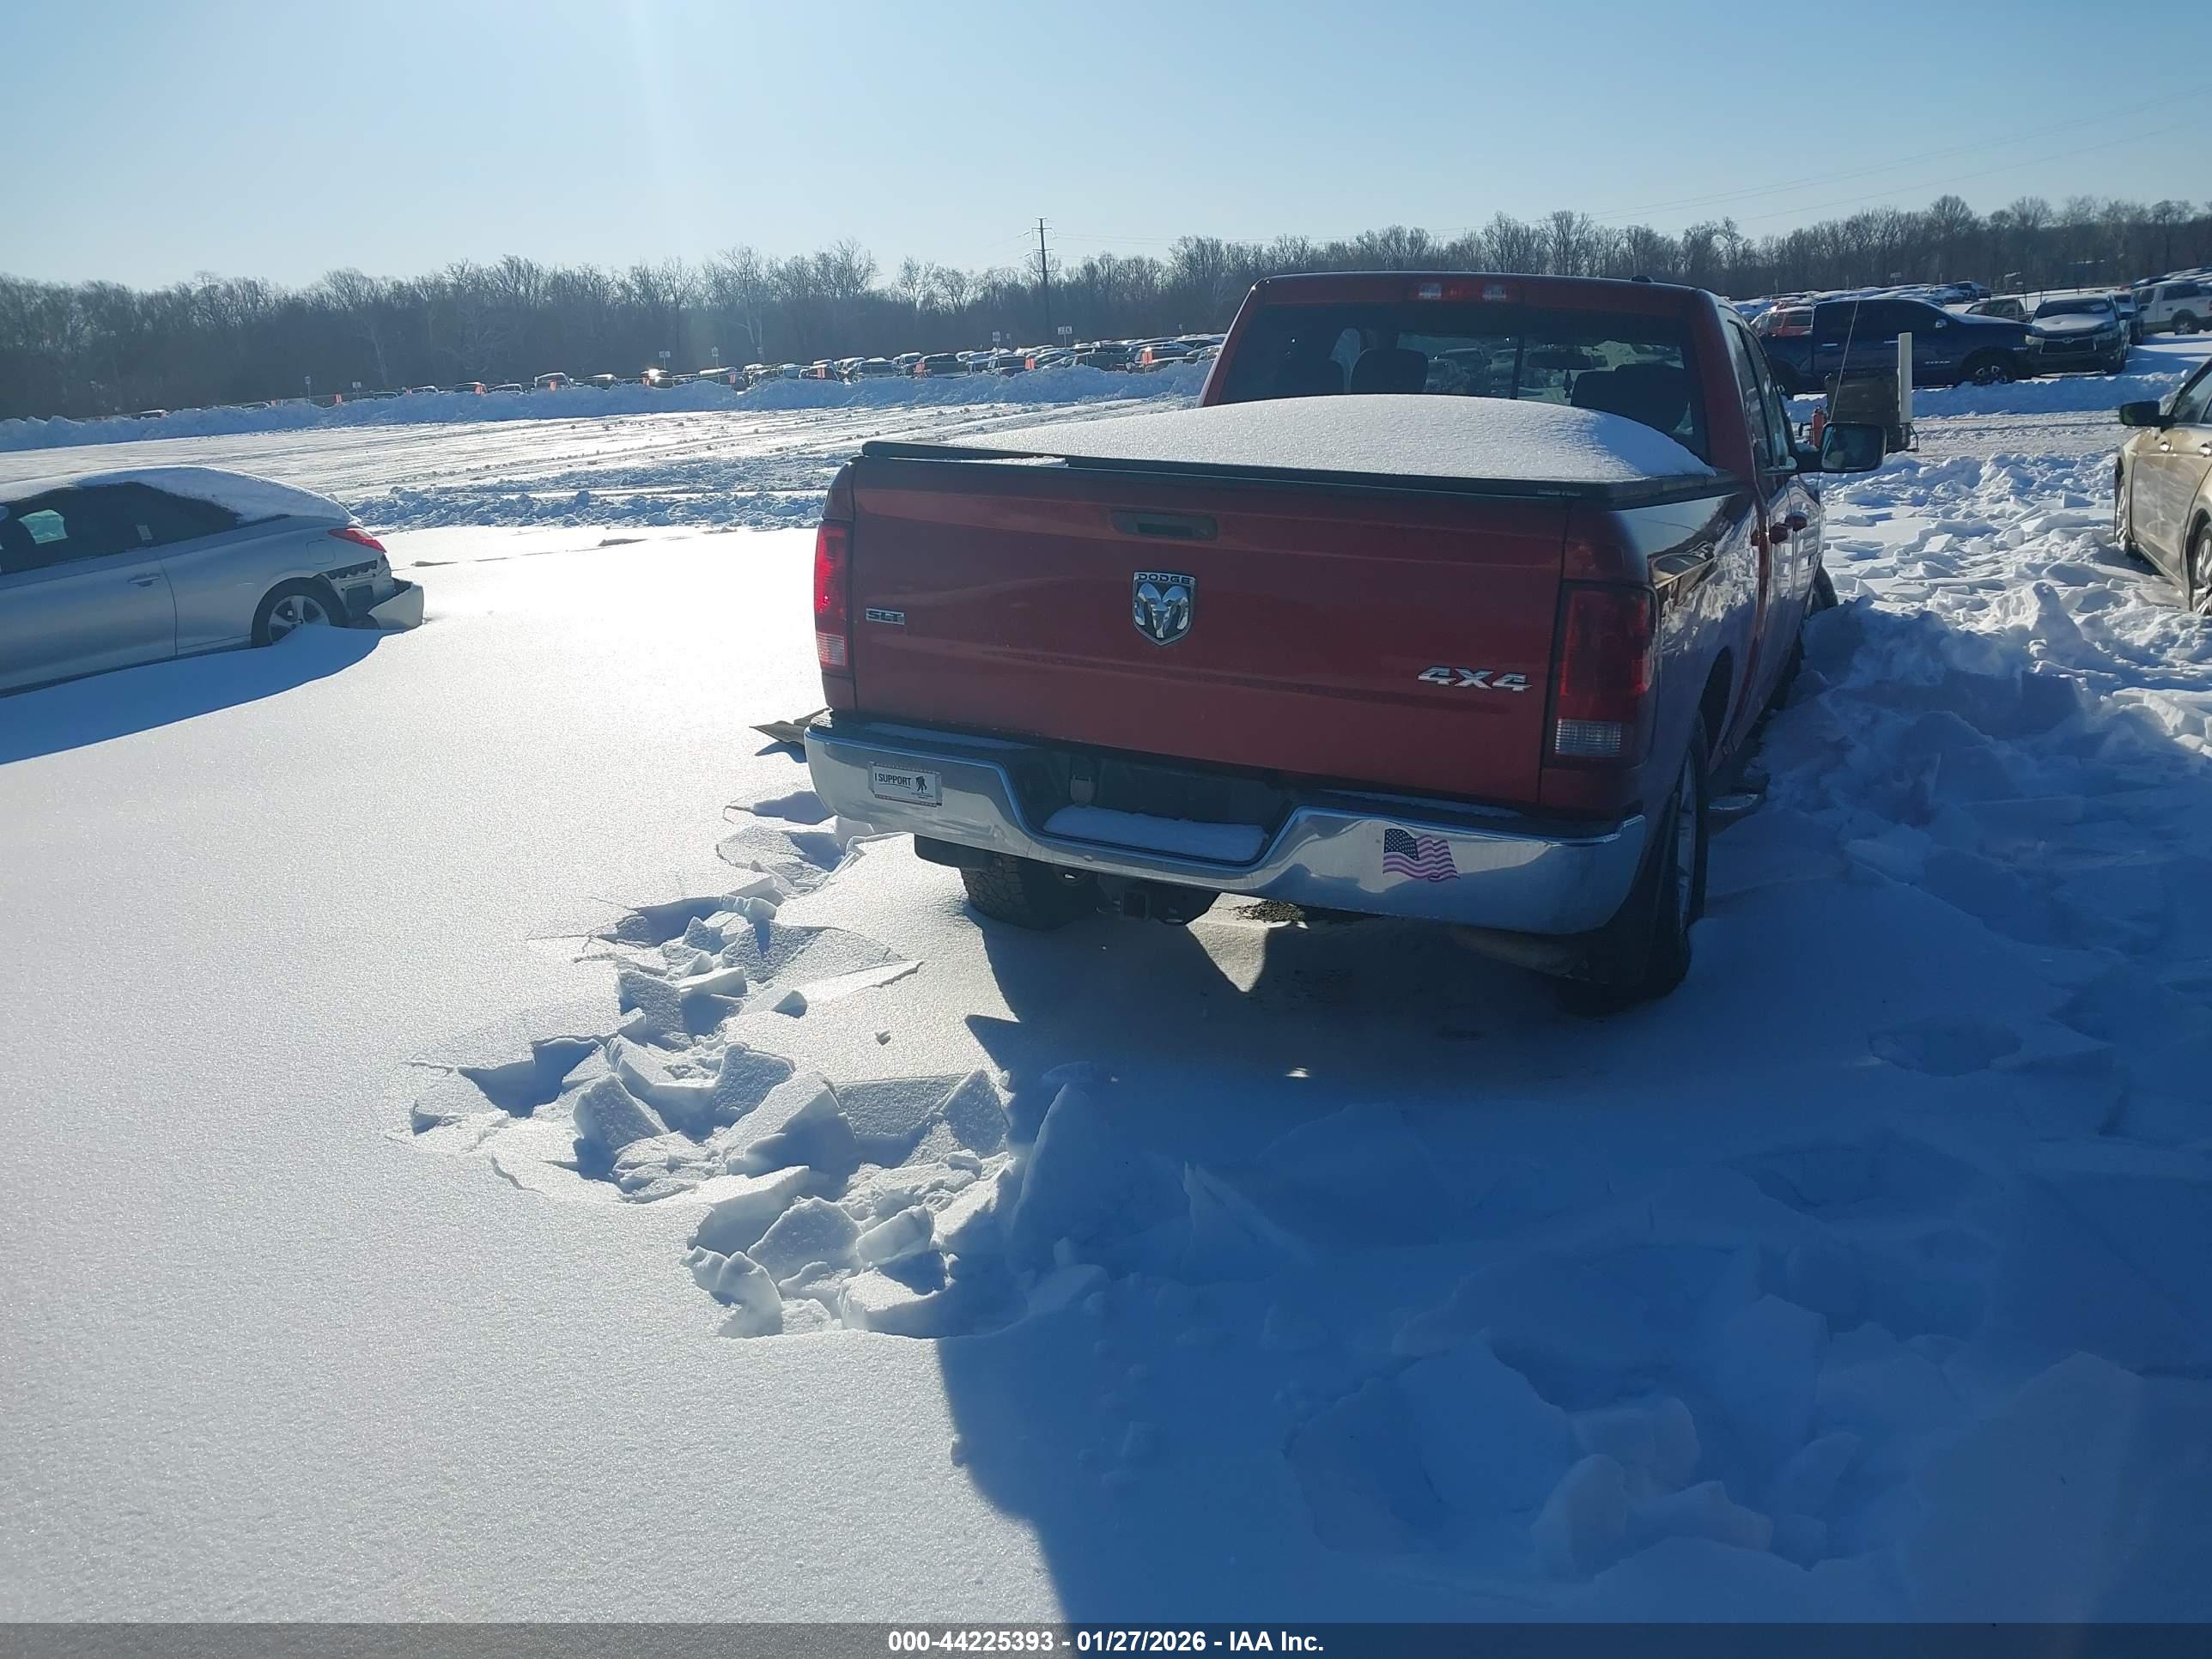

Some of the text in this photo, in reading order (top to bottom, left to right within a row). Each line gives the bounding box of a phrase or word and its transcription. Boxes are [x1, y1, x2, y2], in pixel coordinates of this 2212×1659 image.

[1138, 573, 1191, 585] DODGE
[866, 609, 903, 623] SLT
[1417, 666, 1533, 692] 4X4
[874, 772, 912, 787] I SUPPORT
